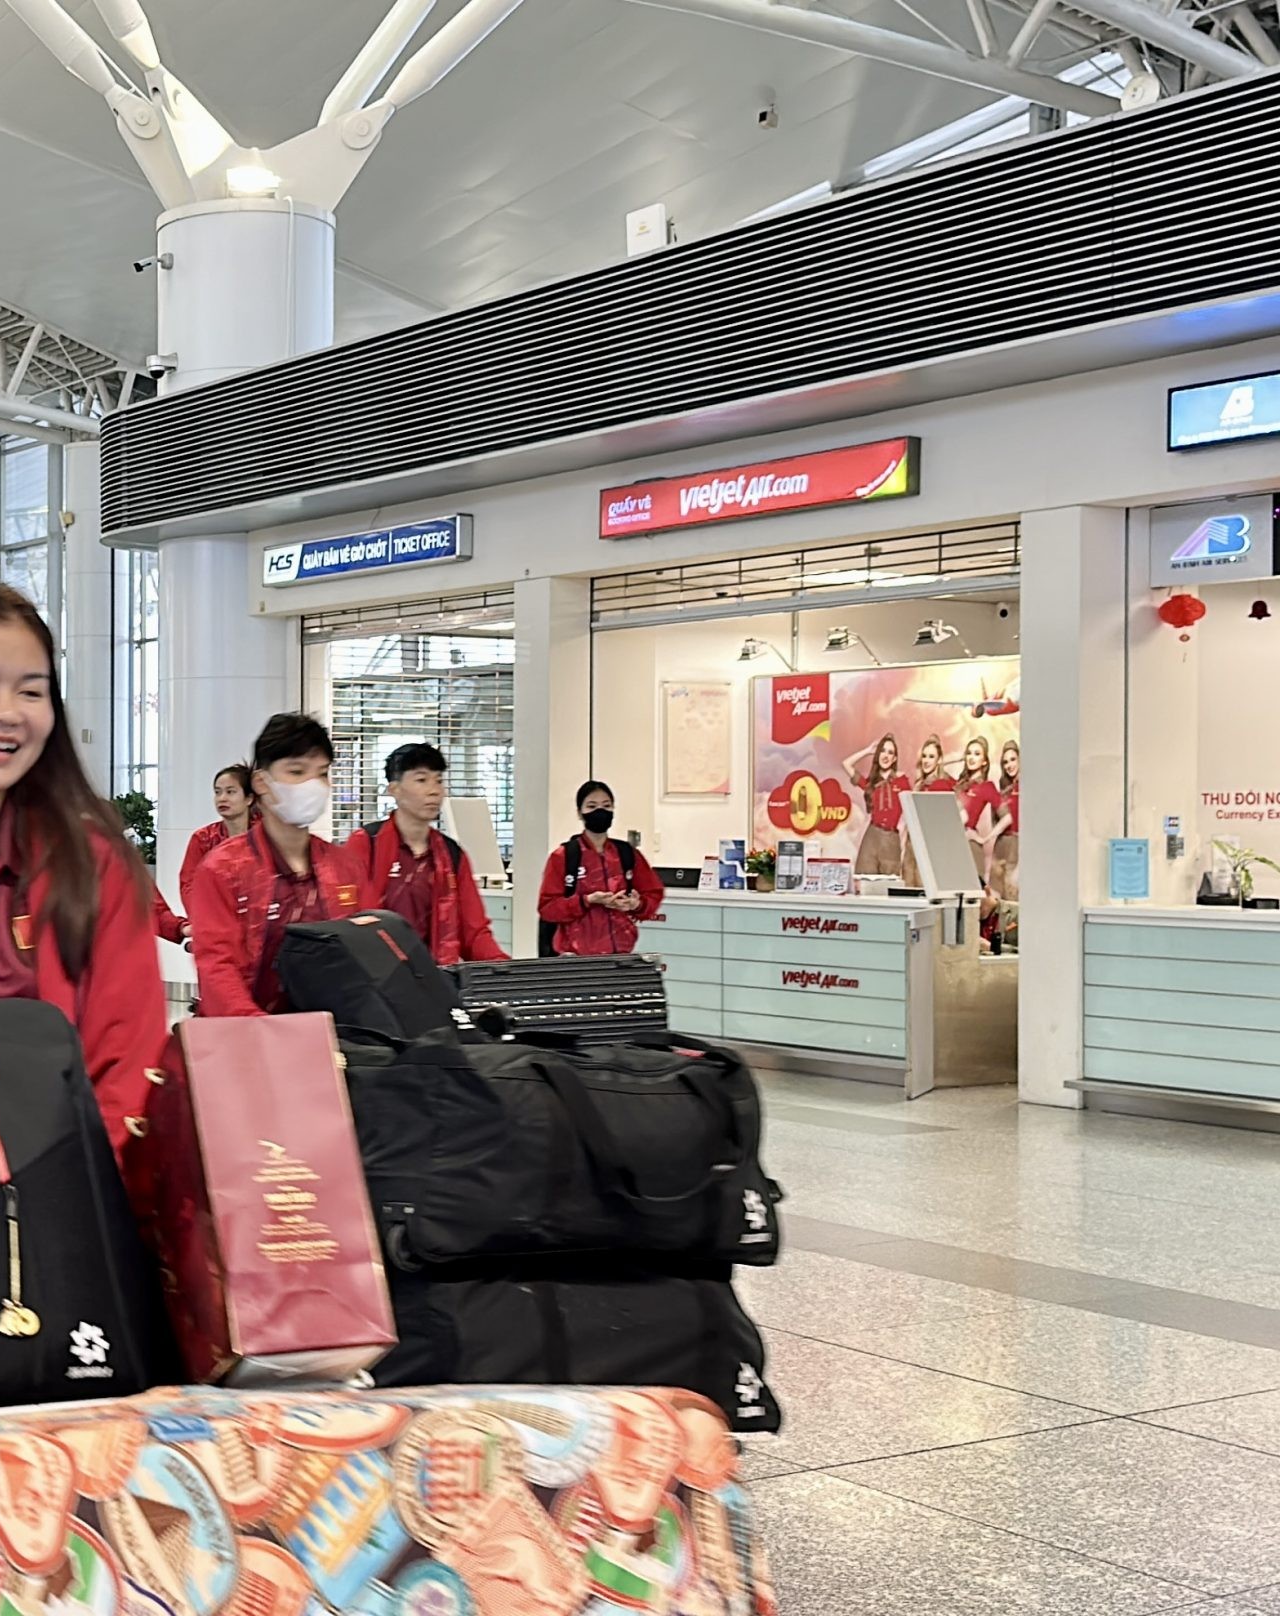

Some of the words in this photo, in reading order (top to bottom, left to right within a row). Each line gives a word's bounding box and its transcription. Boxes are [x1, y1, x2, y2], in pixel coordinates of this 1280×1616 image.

[393, 534, 421, 556] TICKET
[420, 530, 451, 551] OFFICE
[1200, 792, 1230, 805] THU
[819, 806, 848, 820] VND
[1215, 809, 1264, 822] Currency
